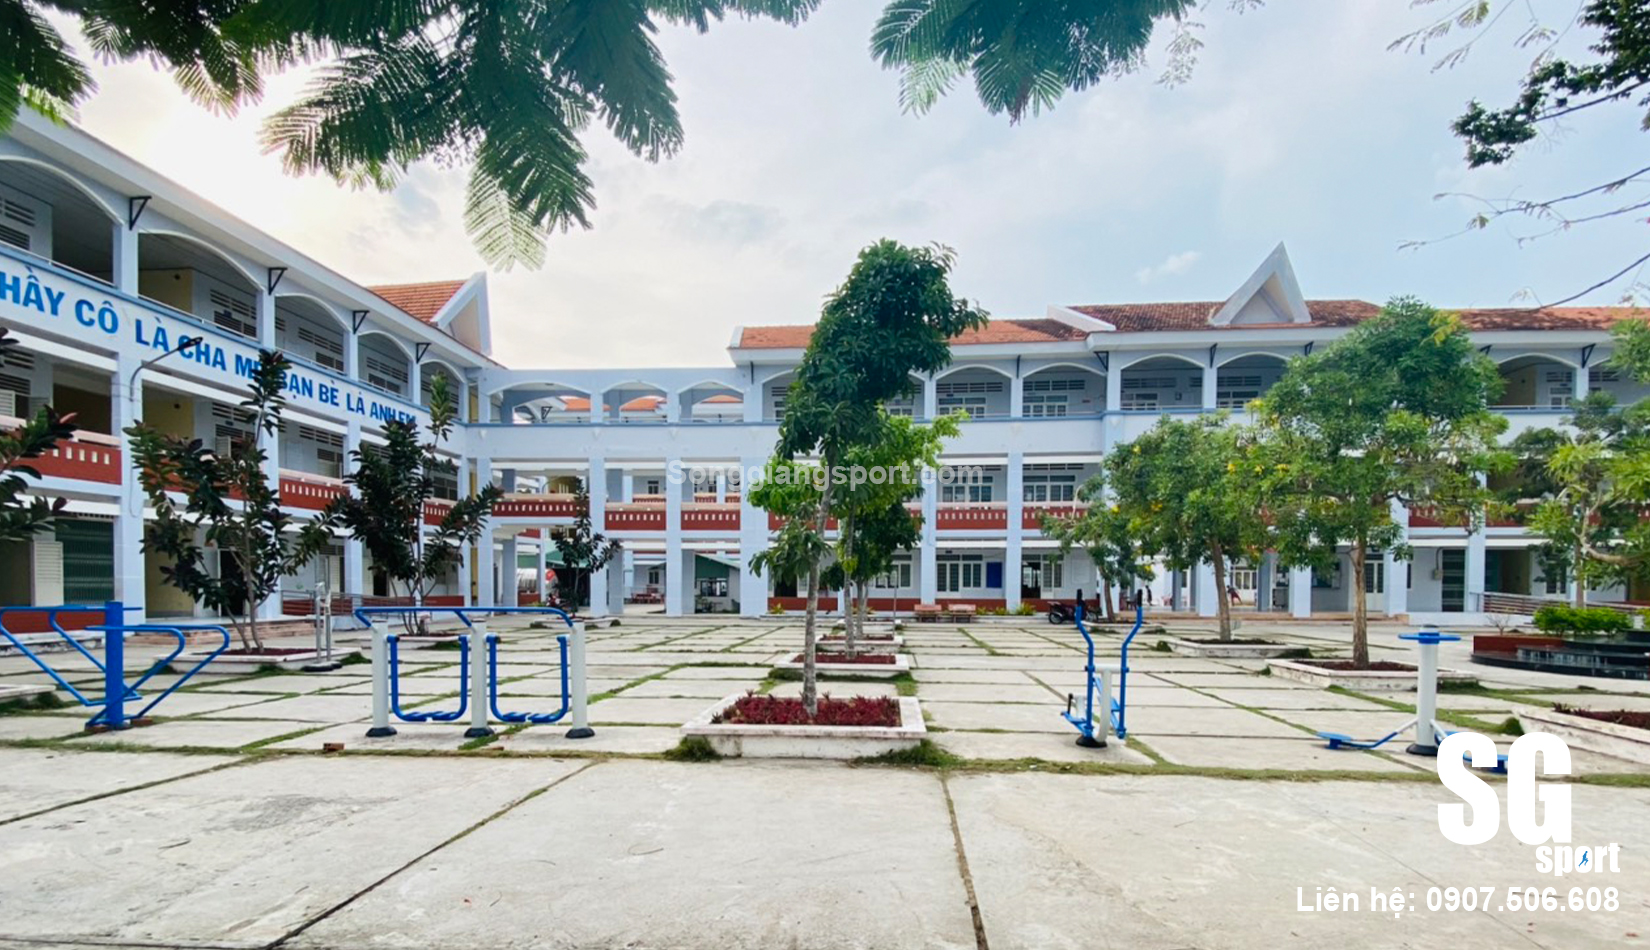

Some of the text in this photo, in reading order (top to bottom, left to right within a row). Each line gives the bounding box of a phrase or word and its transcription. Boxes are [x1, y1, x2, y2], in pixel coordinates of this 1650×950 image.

[75, 299, 119, 334] CÔ
[135, 316, 170, 353] LÀ
[178, 335, 227, 371] CHA
[318, 380, 340, 407] BÈ
[346, 391, 366, 415] LÀ
[370, 402, 396, 421] ANH
